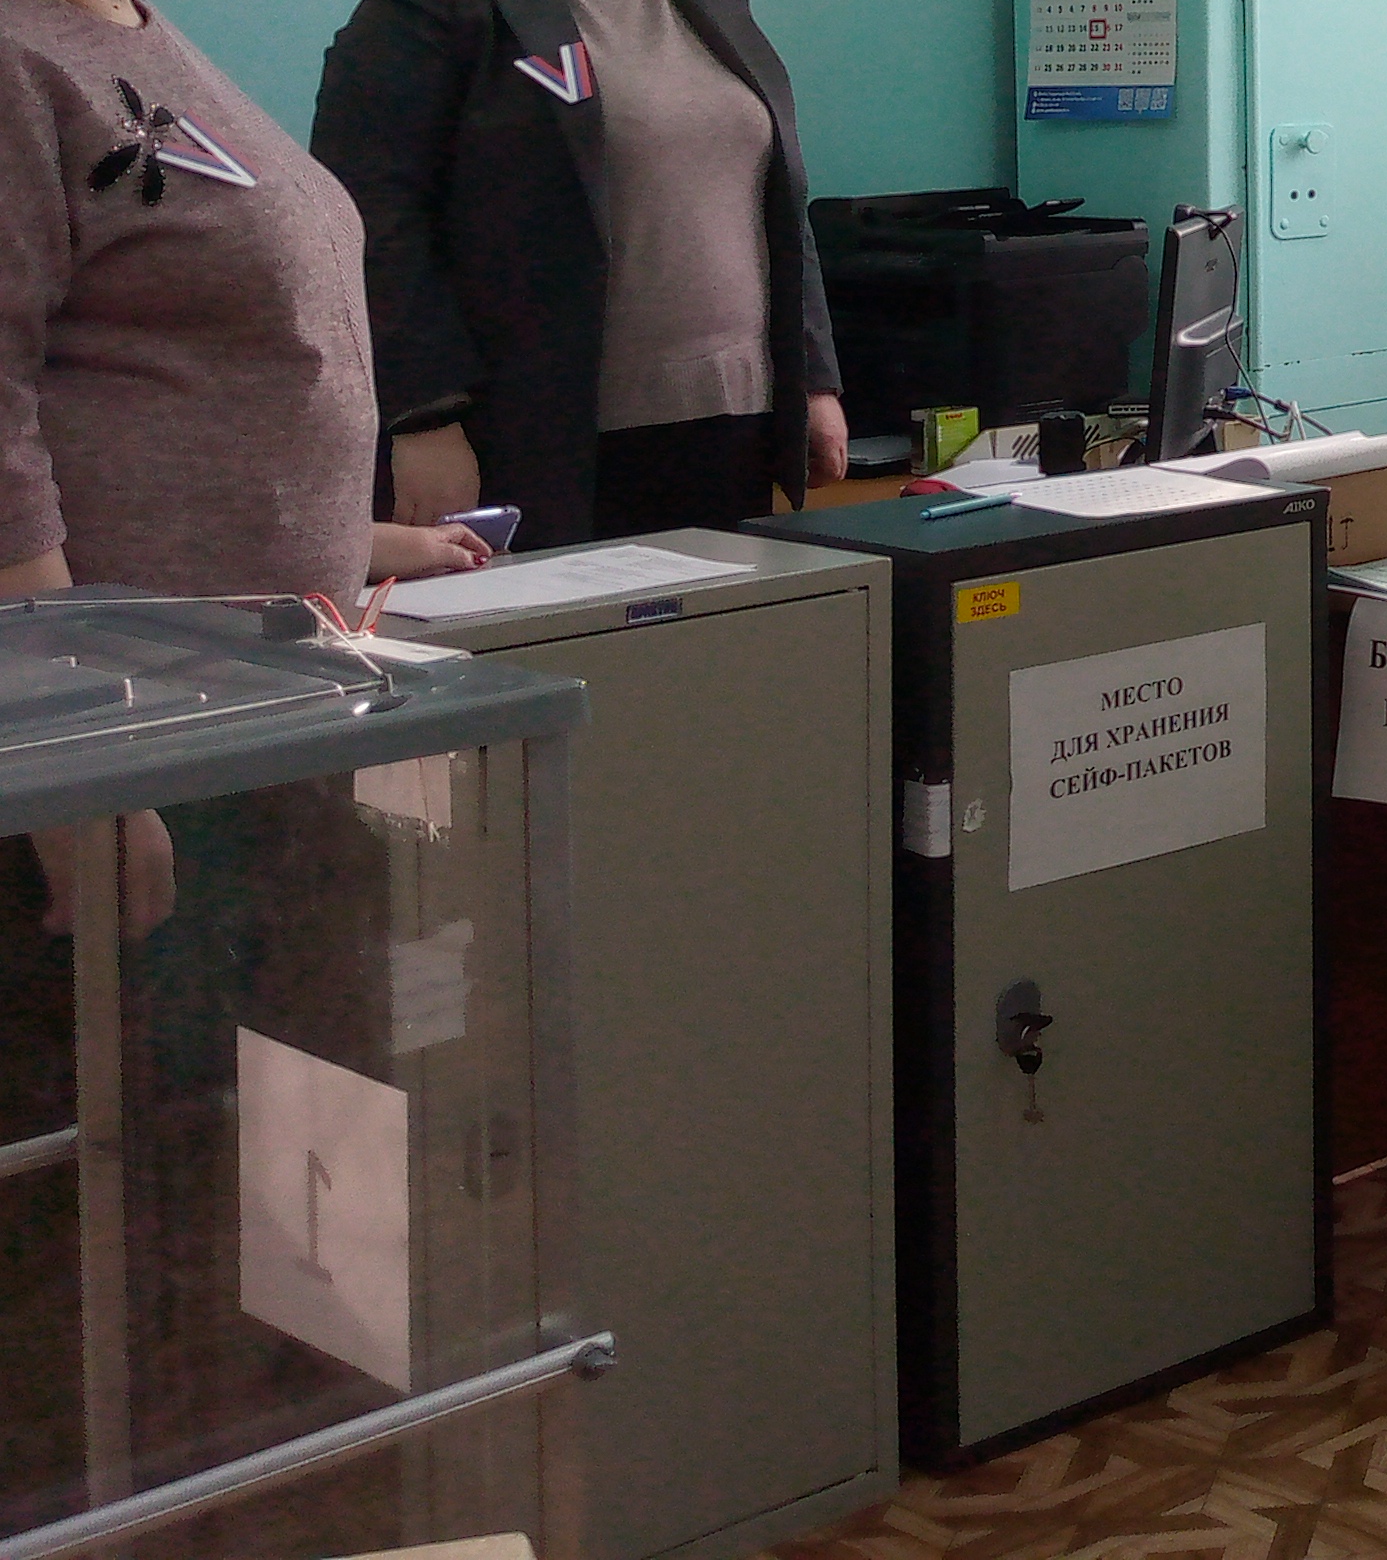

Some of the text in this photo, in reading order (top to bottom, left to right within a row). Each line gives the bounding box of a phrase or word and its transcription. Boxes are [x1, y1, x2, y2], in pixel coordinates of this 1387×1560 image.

[1282, 498, 1316, 515] AIKO
[973, 589, 1005, 603] КЛЮЧ
[971, 603, 1007, 617] ЗДЕСЬ
[1100, 676, 1183, 712] МЕСТО
[1050, 702, 1231, 765] ДЛЯ ХРАНЕНИЯ
[1049, 738, 1232, 800] СЕЙФ-ПАКЕТОВ
